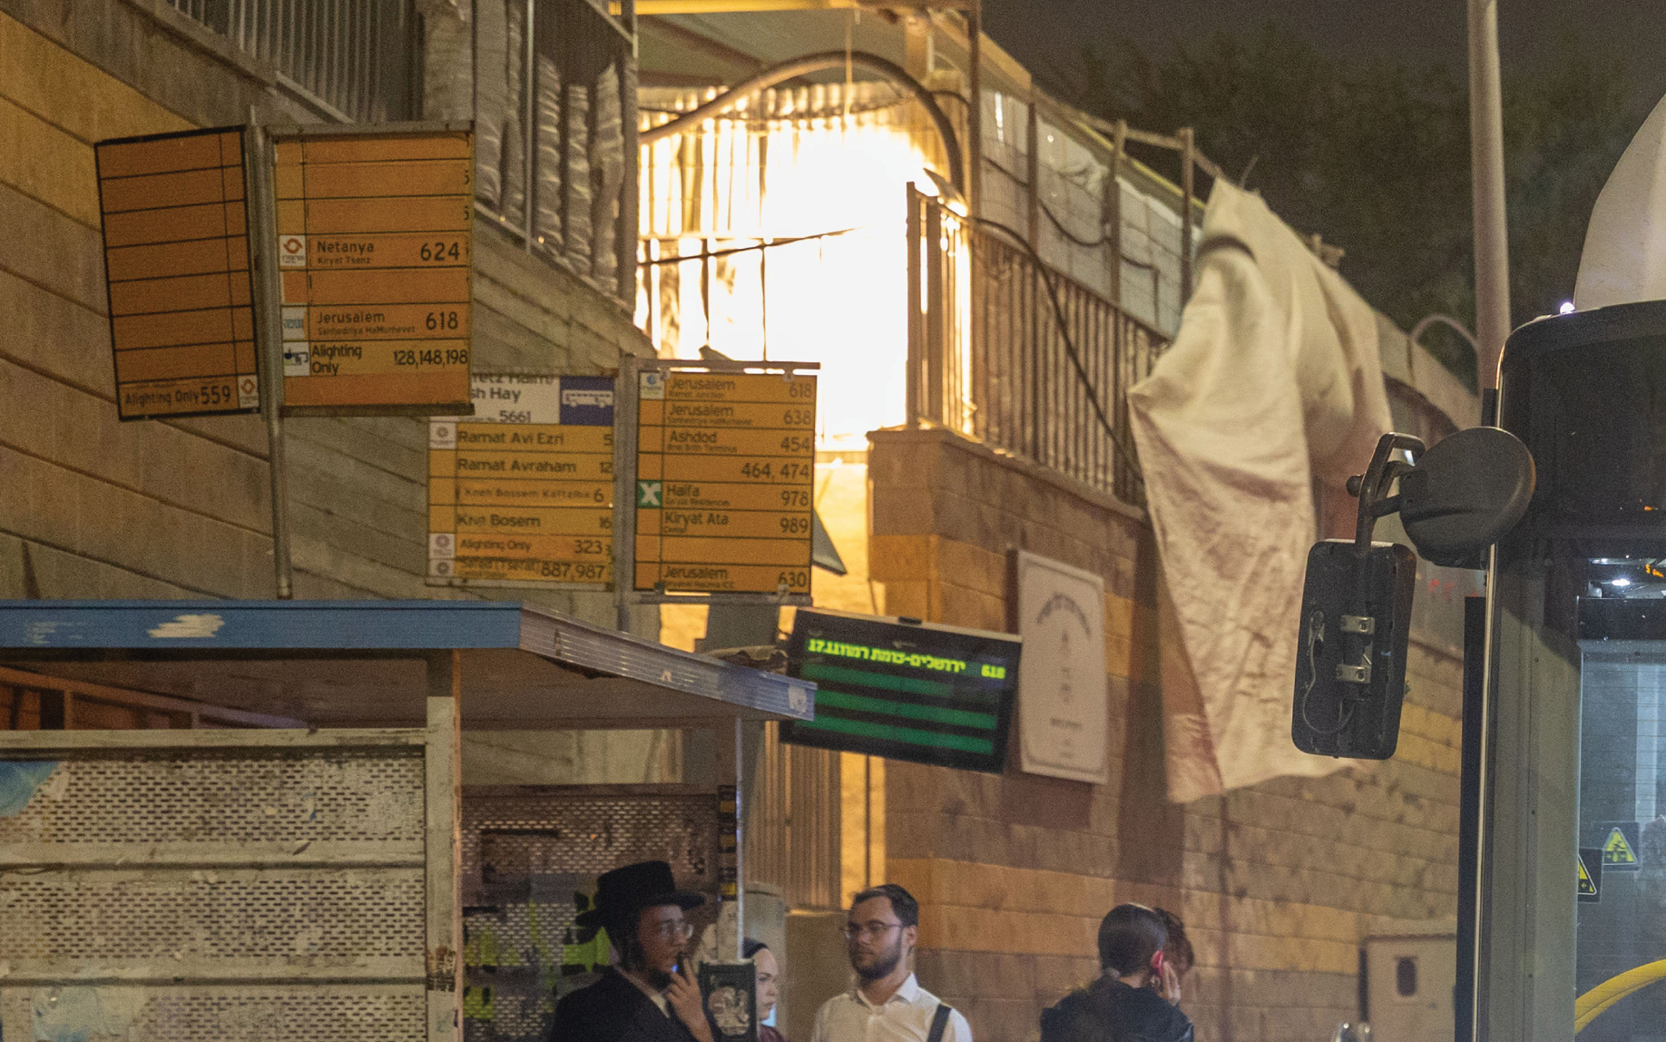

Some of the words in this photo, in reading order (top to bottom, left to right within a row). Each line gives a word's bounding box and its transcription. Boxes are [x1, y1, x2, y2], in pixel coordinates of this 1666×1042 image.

[316, 240, 375, 256] Netanya
[420, 242, 460, 261] 624
[316, 311, 385, 324] Jerusalem
[425, 311, 459, 331] 618
[311, 344, 363, 360] Alighting
[393, 349, 469, 369] 128,148,198
[311, 361, 340, 376] Only
[124, 392, 173, 408] Alighting
[174, 389, 199, 405] Only
[200, 385, 231, 404] 559
[489, 387, 522, 404] Hay
[670, 378, 736, 391] Jerusalem
[788, 382, 812, 398] 618
[499, 411, 532, 424] 5661
[668, 404, 734, 417] Jerusalem
[783, 409, 812, 426] 638
[457, 430, 506, 444] Ramat
[510, 431, 533, 444] Avi
[537, 432, 564, 445] Ezri
[670, 431, 718, 444] Ashdod
[780, 437, 810, 452] 454
[457, 458, 506, 471] Ramat
[510, 460, 577, 473] Avraham
[779, 463, 810, 479] 474
[593, 488, 604, 503] 6
[667, 484, 700, 497] Haifa
[780, 491, 809, 507] 978
[490, 514, 541, 528] Bosem
[664, 511, 703, 529] Kiryat
[706, 512, 729, 525] Ata
[779, 518, 809, 534] 989
[574, 539, 603, 554] 323
[664, 566, 728, 580] Jerusalem
[777, 571, 807, 588] 630
